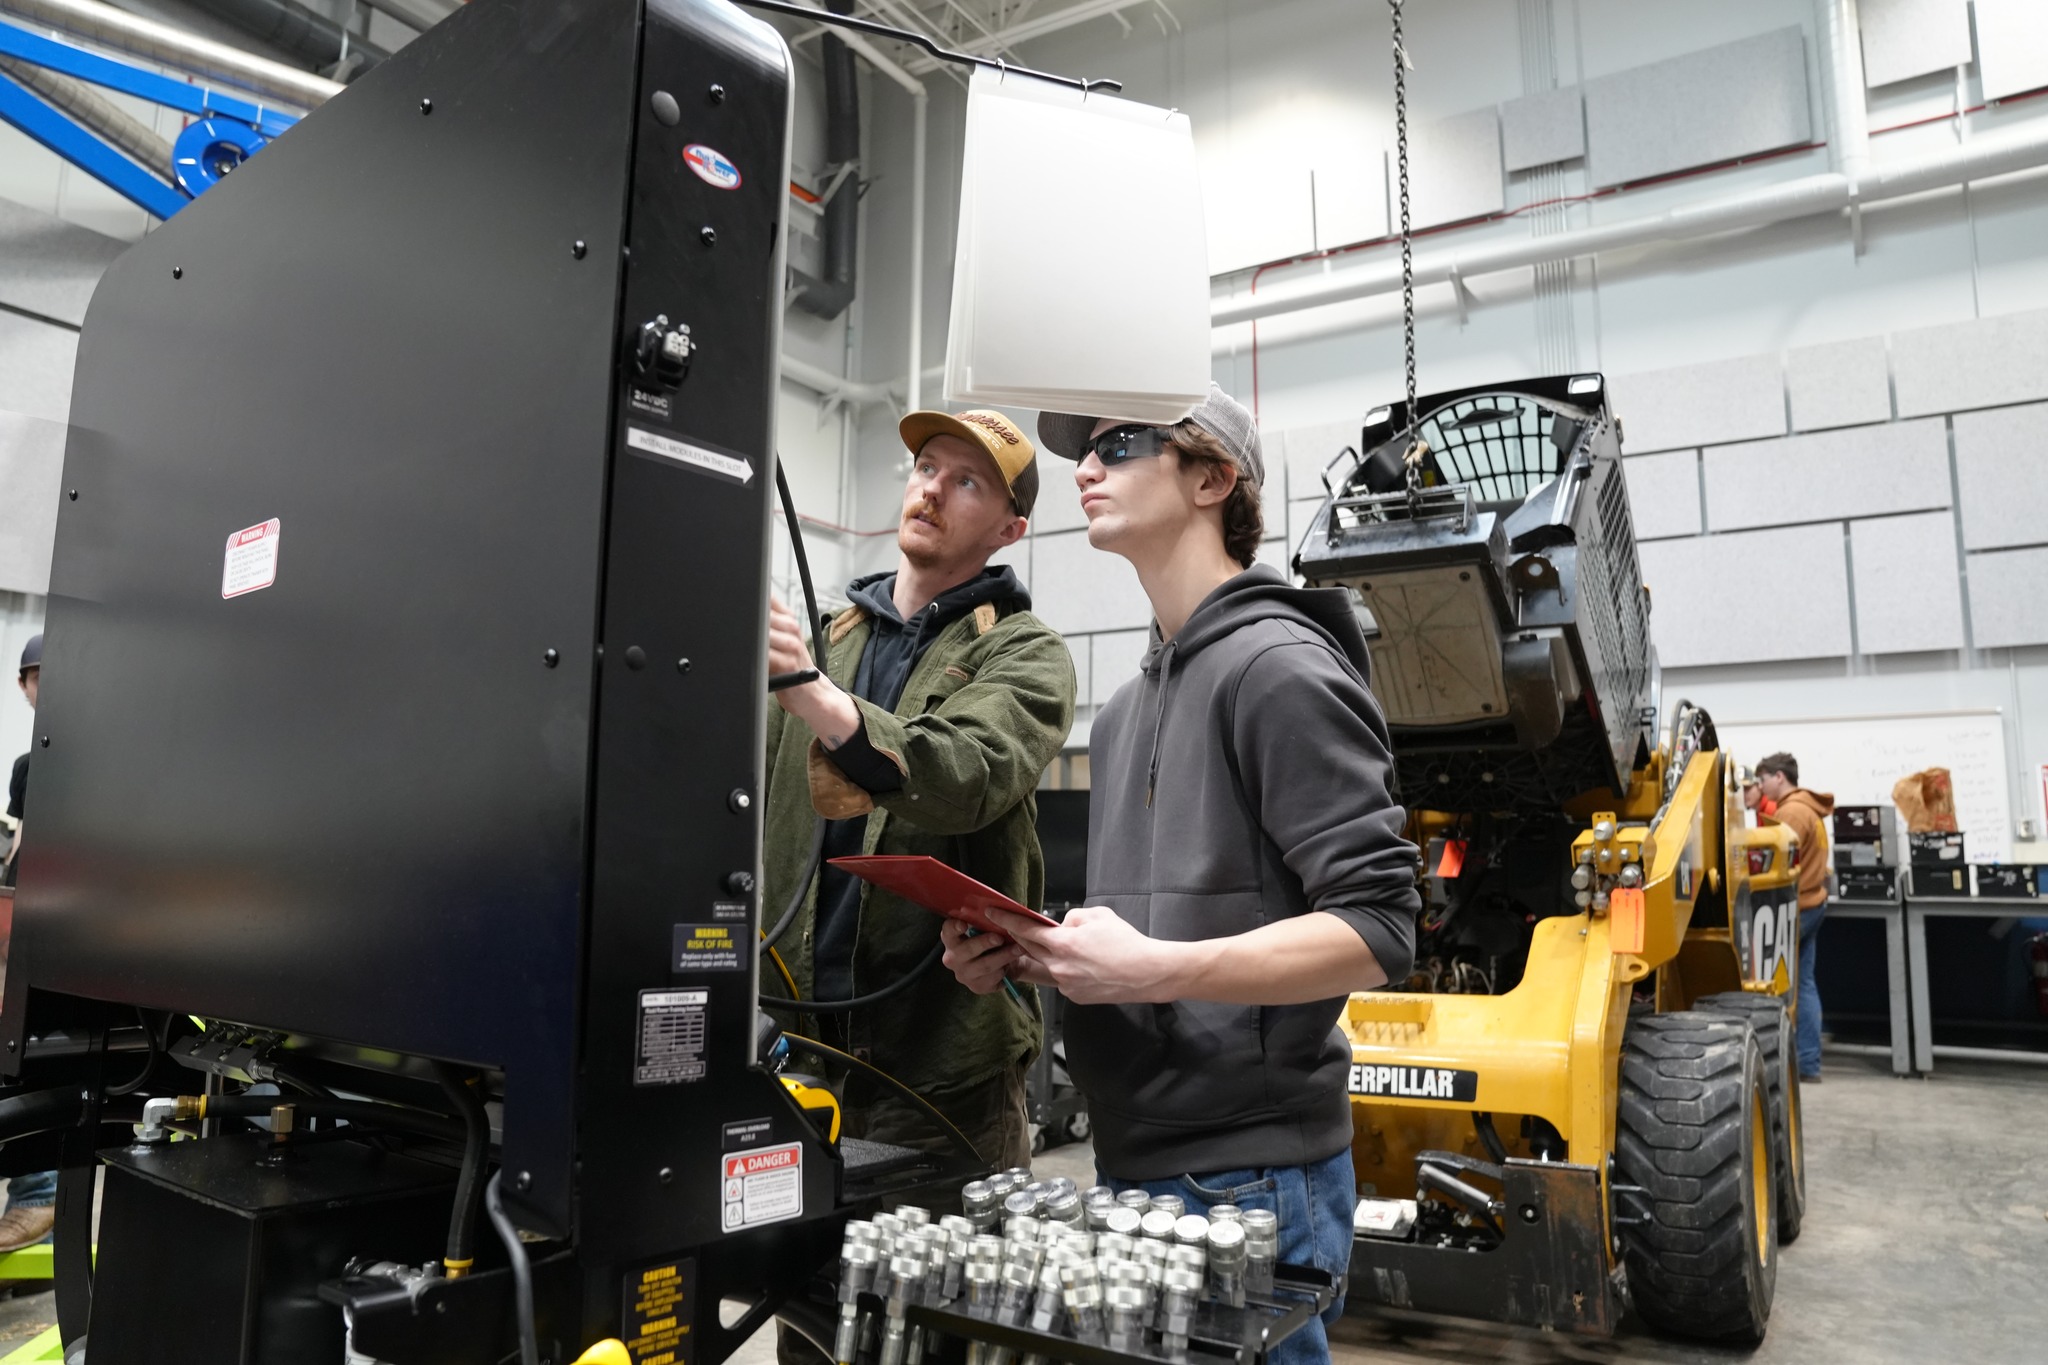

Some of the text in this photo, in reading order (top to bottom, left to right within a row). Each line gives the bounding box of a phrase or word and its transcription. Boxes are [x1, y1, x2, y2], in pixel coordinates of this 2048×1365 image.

[634, 389, 669, 408] 24VDC
[640, 435, 742, 473] INSTALL MODULES IN THIS SLOT
[687, 940, 733, 949] RISK OF FIRE
[1753, 900, 1797, 986] CAT
[748, 1152, 791, 1171] DANGER
